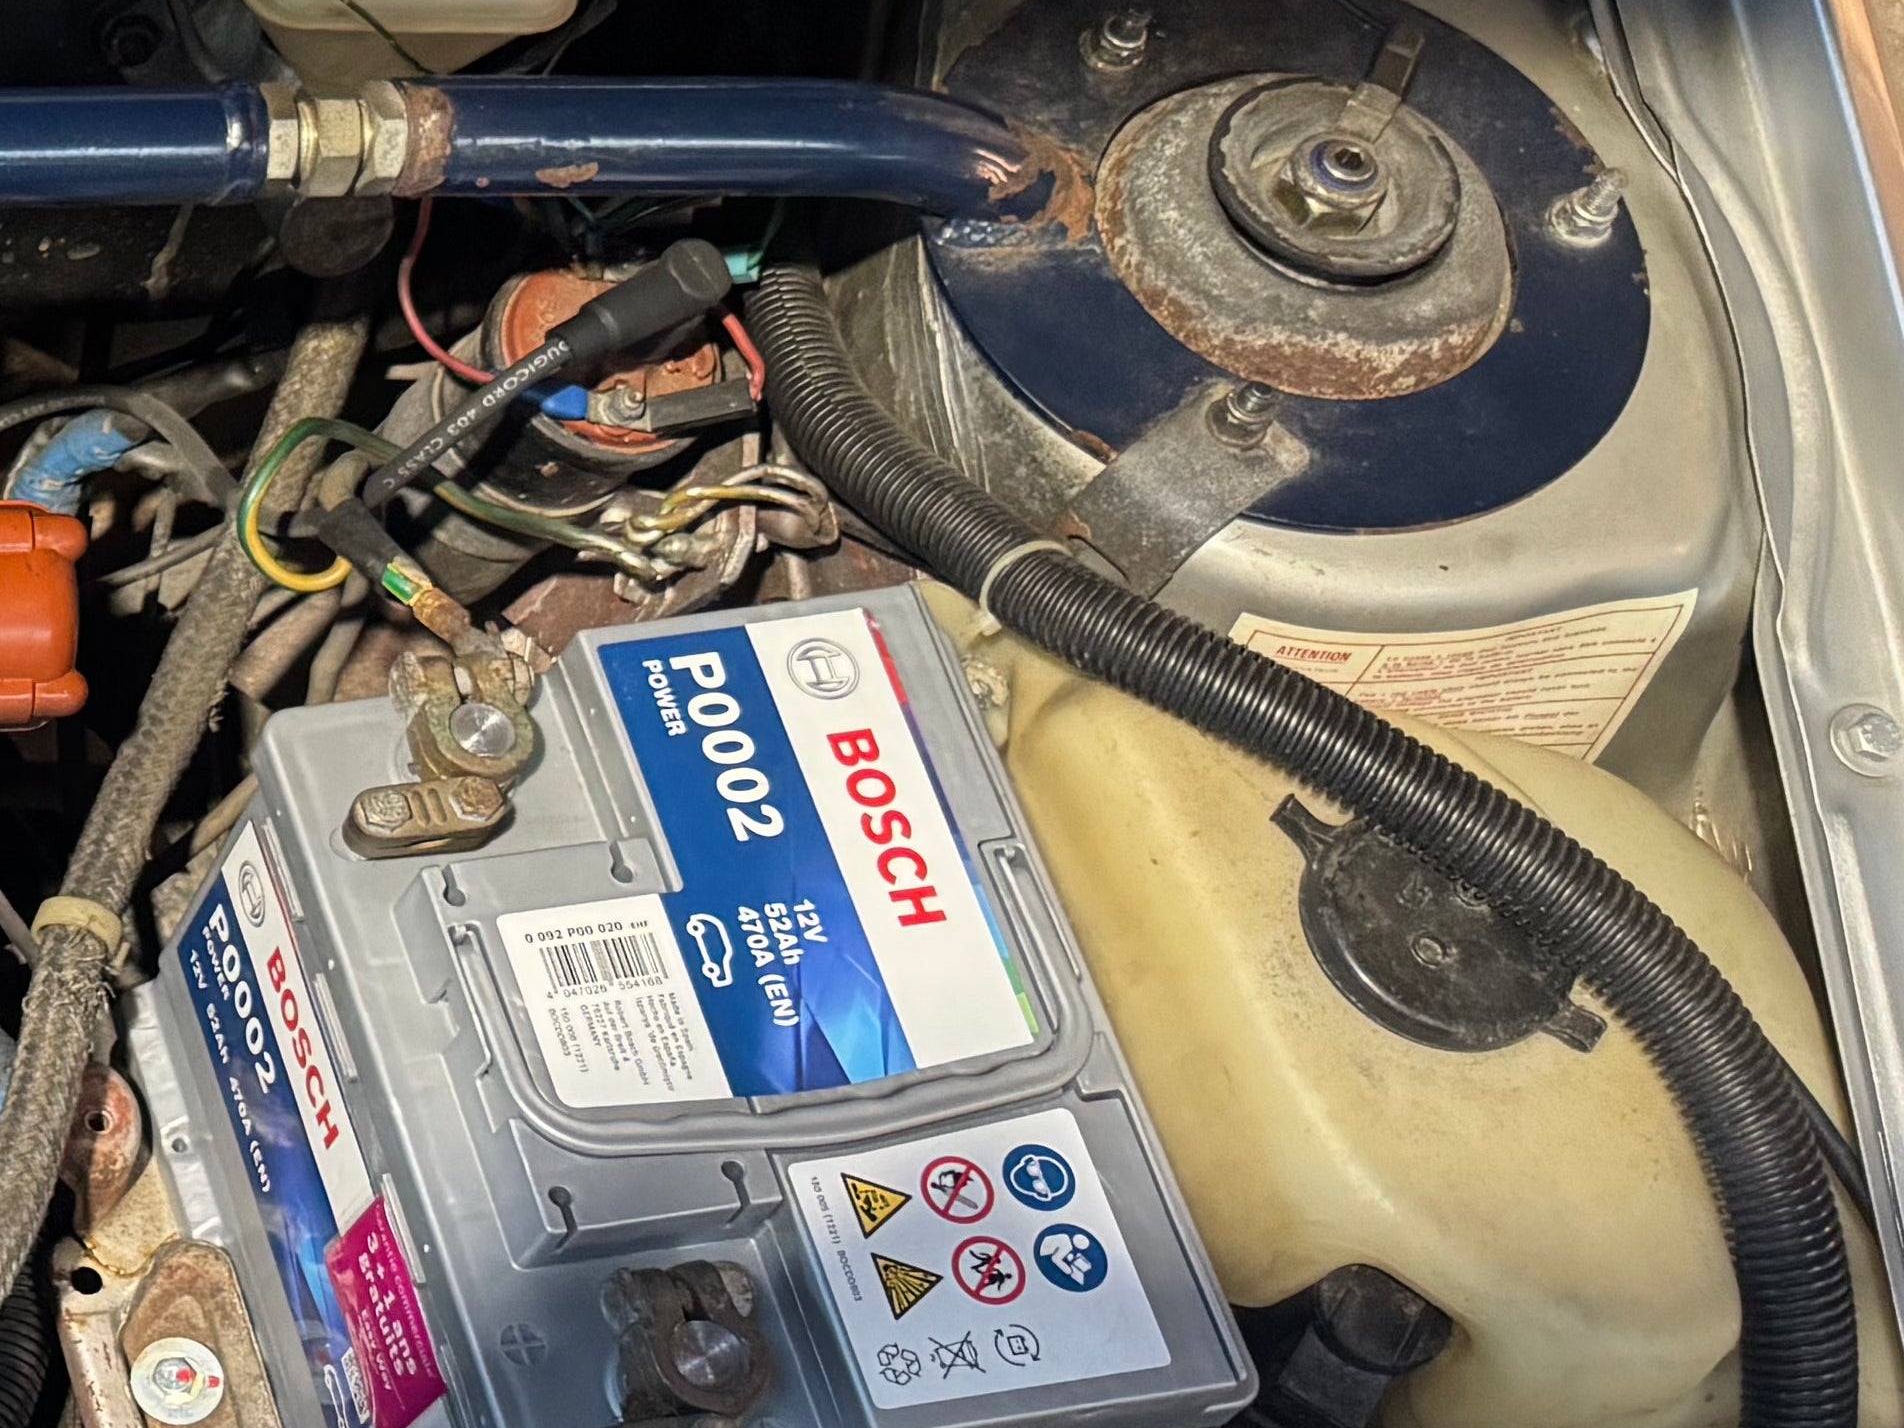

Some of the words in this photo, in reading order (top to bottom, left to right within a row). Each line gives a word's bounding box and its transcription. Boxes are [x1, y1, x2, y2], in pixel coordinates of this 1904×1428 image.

[481, 339, 572, 410] OUGICORD
[399, 435, 446, 473] CLASS
[443, 407, 477, 438] 403
[1276, 645, 1352, 662] ATTENTION
[642, 659, 687, 736] POWER
[669, 651, 784, 842] P0002
[826, 728, 947, 926] BOSCH
[537, 928, 564, 942] 092
[567, 925, 594, 938] P00
[597, 921, 623, 933] 020
[764, 903, 804, 965] 52Ah
[793, 899, 827, 943] 12V
[202, 926, 230, 1001] POWER
[209, 903, 275, 1094] P0002
[737, 906, 774, 968] 470A
[758, 974, 799, 1027] (EN)
[190, 949, 207, 989] 12V
[206, 1003, 230, 1064] 52Ah
[229, 1076, 253, 1137] 470A
[249, 1139, 271, 1193] (EN)
[266, 946, 339, 1150] BOSCH
[358, 1252, 404, 1376] gratuits
[367, 1231, 379, 1254] 3
[383, 1290, 396, 1311] 1
[392, 1319, 417, 1375] ans
